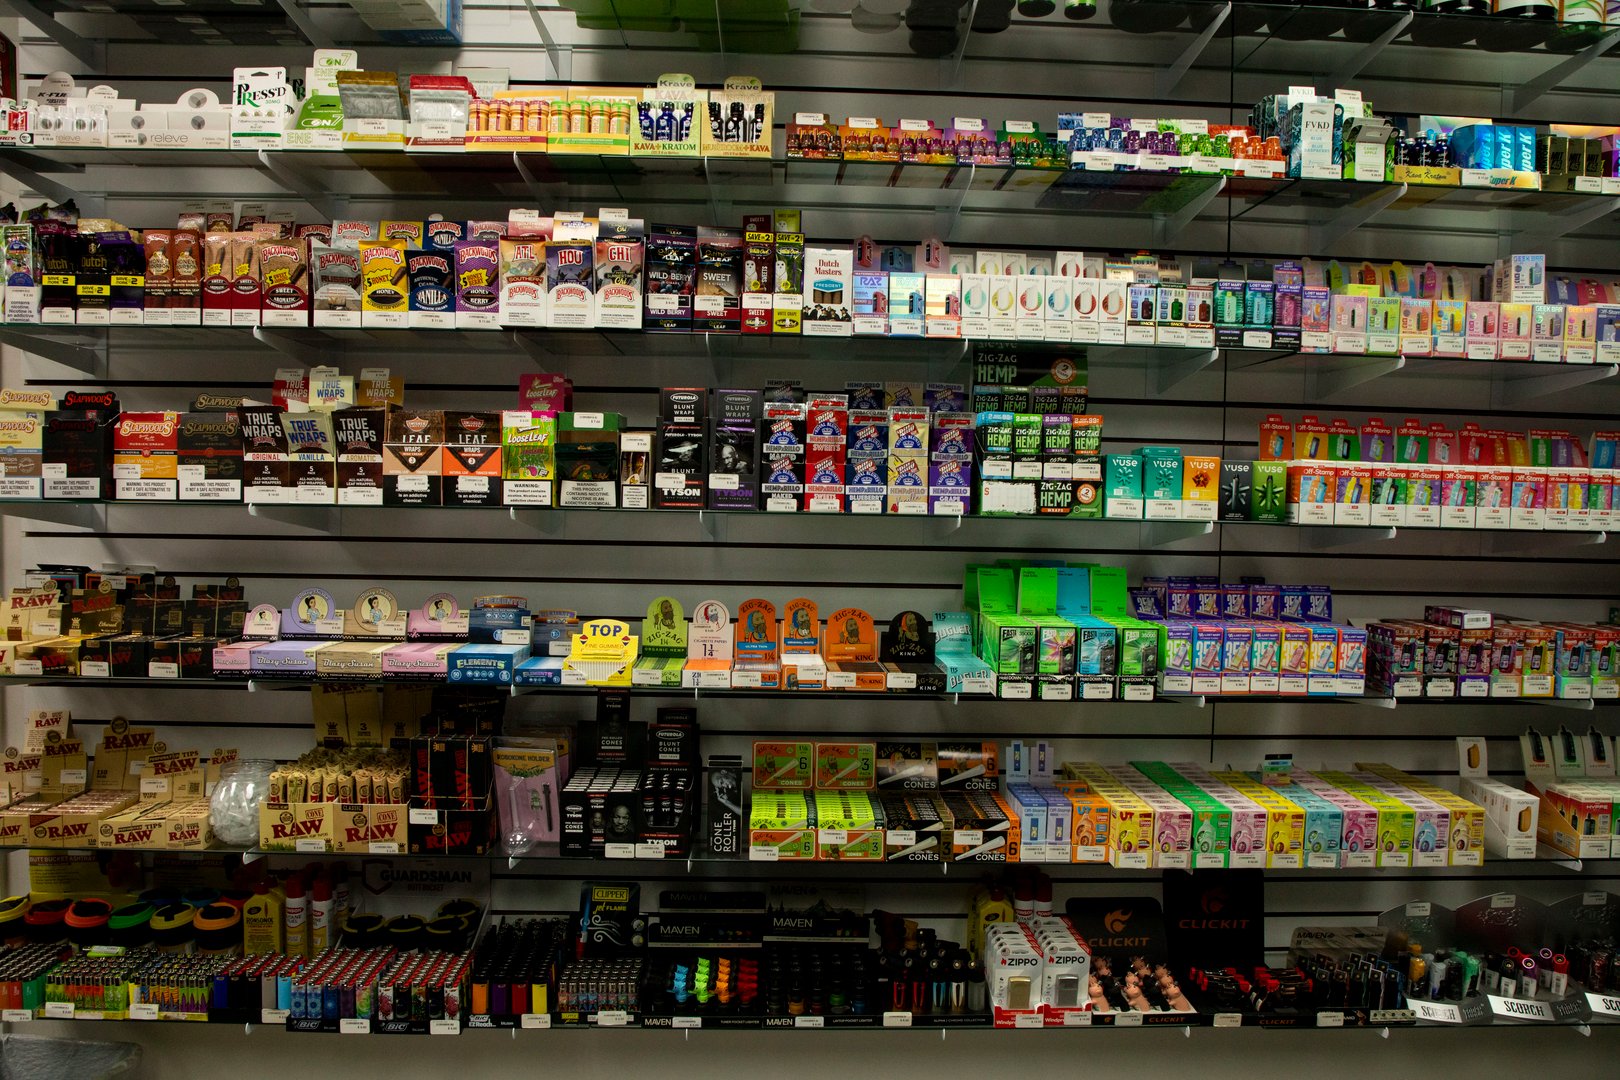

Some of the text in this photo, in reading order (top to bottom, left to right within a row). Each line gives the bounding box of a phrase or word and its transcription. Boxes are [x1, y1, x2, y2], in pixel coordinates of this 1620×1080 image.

[660, 80, 692, 88] Krave
[150, 132, 188, 142] releve
[262, 246, 300, 264] BACKWOODS
[363, 246, 402, 264] BACKWOODS
[460, 245, 497, 264] BACKWOODS
[513, 244, 537, 261] ATL
[558, 249, 584, 266] HOU
[608, 245, 632, 262] CHI
[320, 253, 358, 273] BACKWOODS
[409, 256, 448, 274] BACKWOODS
[818, 259, 840, 268] Dutch
[649, 272, 692, 282] WILD BERRY
[815, 267, 842, 276] Masters
[703, 273, 731, 282] SWEET
[417, 291, 448, 305] VANILLA
[604, 288, 634, 302] BACKWOODS
[978, 353, 1017, 363] ZIG-ZAG
[977, 366, 1017, 383] HEMP
[322, 380, 340, 389] TRUE
[371, 380, 390, 389] TRUE
[2, 391, 50, 405] SLAPWOODS
[66, 393, 113, 405] SLAPWOODS
[245, 413, 273, 425] TRUE
[340, 418, 368, 430] TRUE
[121, 422, 173, 435] SLAPWOODS
[186, 423, 237, 435] SLAPWOODS
[242, 425, 282, 437] WRAPS
[290, 420, 318, 432] TRUE
[987, 426, 1012, 434] ZIG-ZAG
[288, 432, 327, 443] WRAPS
[336, 430, 376, 442] WRAPS
[402, 435, 430, 443] LEAF
[459, 434, 487, 444] LEAF
[987, 434, 1011, 446] HEMP
[1015, 435, 1040, 447] HEMP
[1045, 436, 1070, 448] HEMP
[1074, 437, 1099, 450] HEMP
[1304, 468, 1334, 476] Off-Stamp
[1375, 471, 1406, 479] Off-Stamp
[1409, 472, 1440, 480] Off-Stamp
[1480, 474, 1510, 482] Off-Stamp
[1041, 482, 1072, 490] ZIG-ZAG
[662, 489, 701, 497] TYSON
[1040, 491, 1071, 507] HEMP
[11, 594, 56, 609] RAW
[740, 602, 774, 613] ZIG-ZAG
[833, 609, 868, 622] ZIG-ZAG
[935, 612, 946, 620] 115
[590, 624, 622, 637] TOP
[647, 631, 683, 644] ZIG-ZAG
[257, 657, 308, 666] Blazy Susan
[323, 659, 374, 668] Blazy Susan
[388, 659, 440, 668] Blazy Susan
[457, 659, 506, 669] ELEMENTS
[35, 718, 61, 727] RAW
[104, 733, 153, 749] RAW
[4, 758, 41, 772] RAW
[799, 757, 807, 769] 6
[861, 758, 869, 770] 3
[904, 781, 936, 789] CONES
[306, 810, 323, 819] CONE
[378, 812, 397, 822] CONE
[48, 824, 88, 838] RAW
[272, 819, 323, 838] RAW
[345, 823, 397, 842] RAW
[723, 812, 732, 852] ROLLER
[115, 831, 152, 845] RAW
[169, 831, 199, 841] RAW
[713, 822, 722, 852] CONE
[1009, 841, 1018, 855] 6
[908, 853, 940, 861] CONES
[976, 852, 1006, 861] CONES
[381, 870, 472, 883] GUARDSMAN
[596, 890, 625, 898] CLIPPER
[593, 902, 605, 914] jet
[773, 918, 813, 929] MAVEN
[1178, 919, 1250, 930] CLICKIT
[660, 925, 700, 935] MAVEN
[1089, 937, 1149, 947] CLICKIT
[1008, 958, 1038, 966] ZIPPO
[1056, 956, 1085, 964] ZIPPO
[1504, 1001, 1545, 1016] SCORCH
[298, 1020, 319, 1030] BIC
[385, 1021, 408, 1031] BIC
[645, 1018, 672, 1026] MAVEN
[766, 1018, 793, 1026] MAVEN
